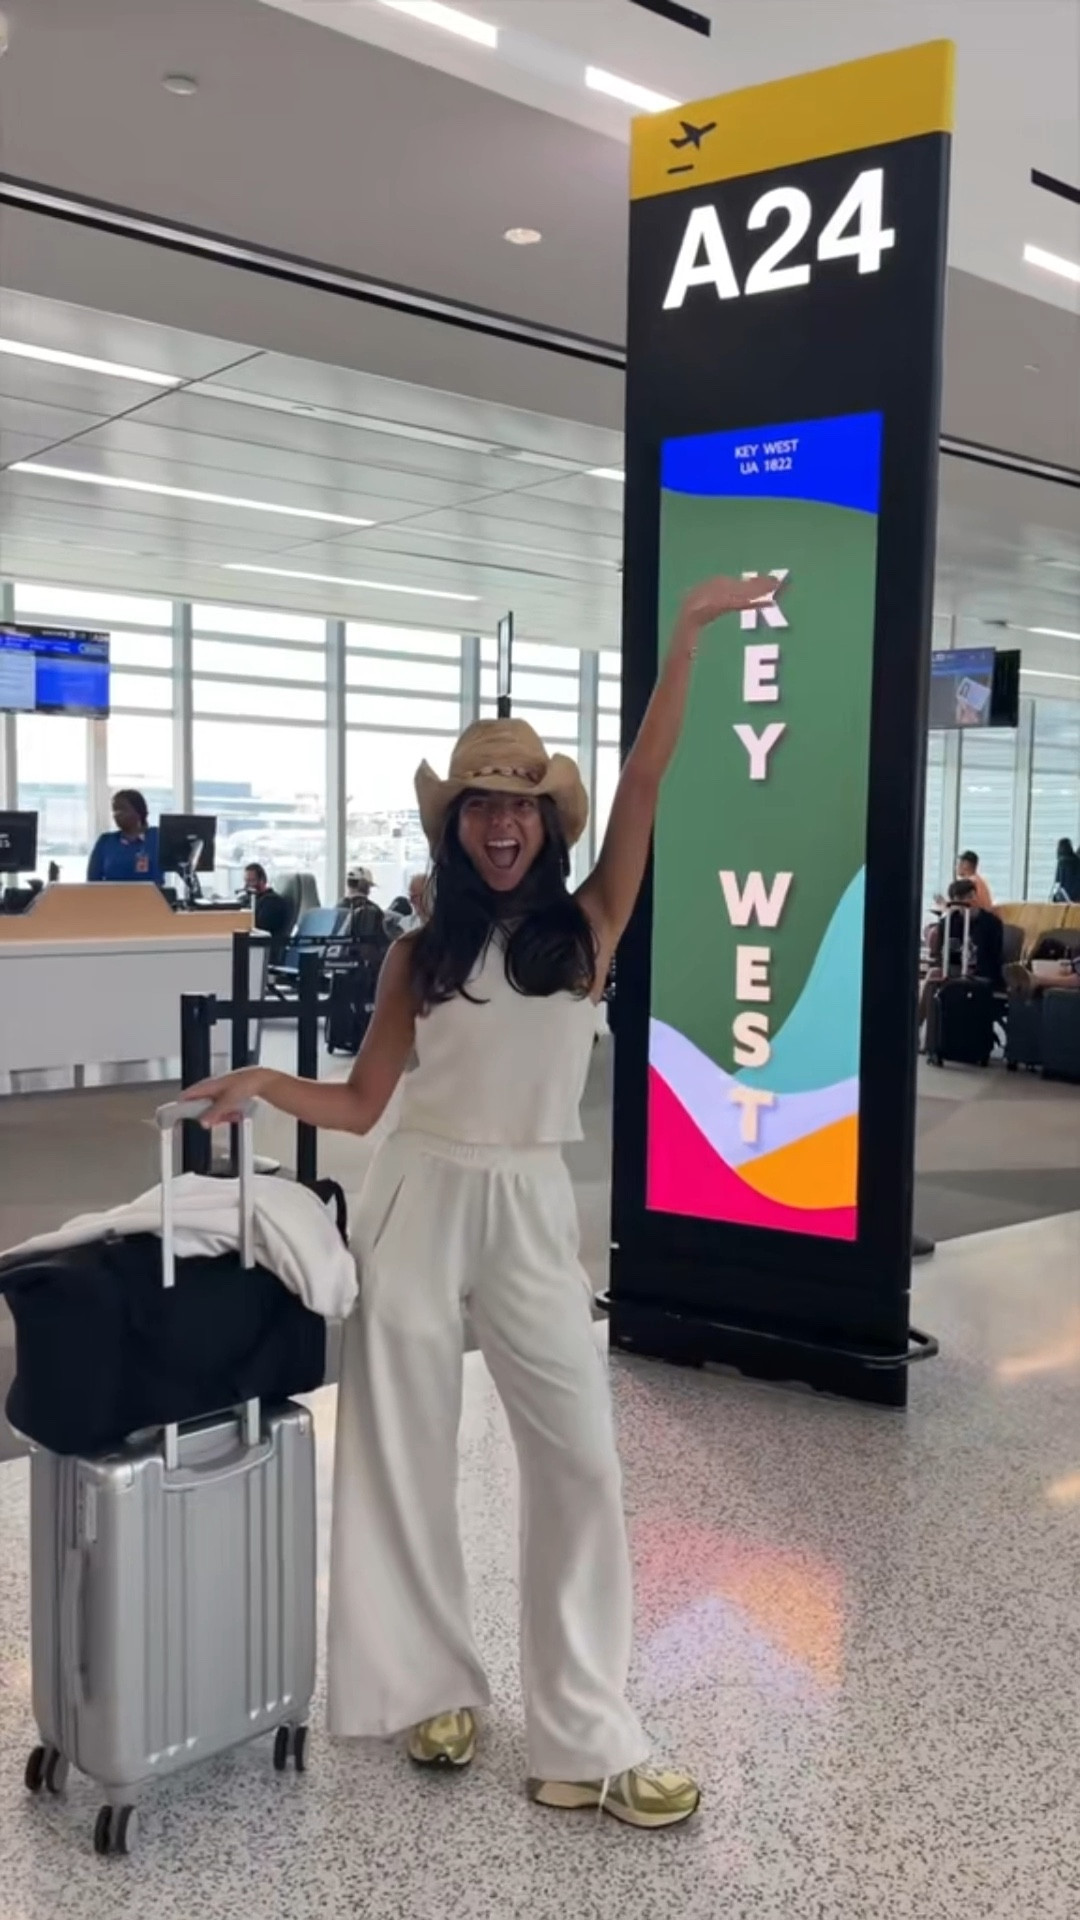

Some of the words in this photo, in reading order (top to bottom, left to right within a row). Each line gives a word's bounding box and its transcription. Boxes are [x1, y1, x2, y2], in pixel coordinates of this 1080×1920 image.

[662, 167, 895, 310] A24
[734, 443, 759, 459] KEY
[763, 438, 799, 455] WEST
[740, 461, 759, 475] UA
[764, 456, 792, 472] 1822
[732, 568, 790, 780] KEY
[718, 870, 794, 1143] WEST
